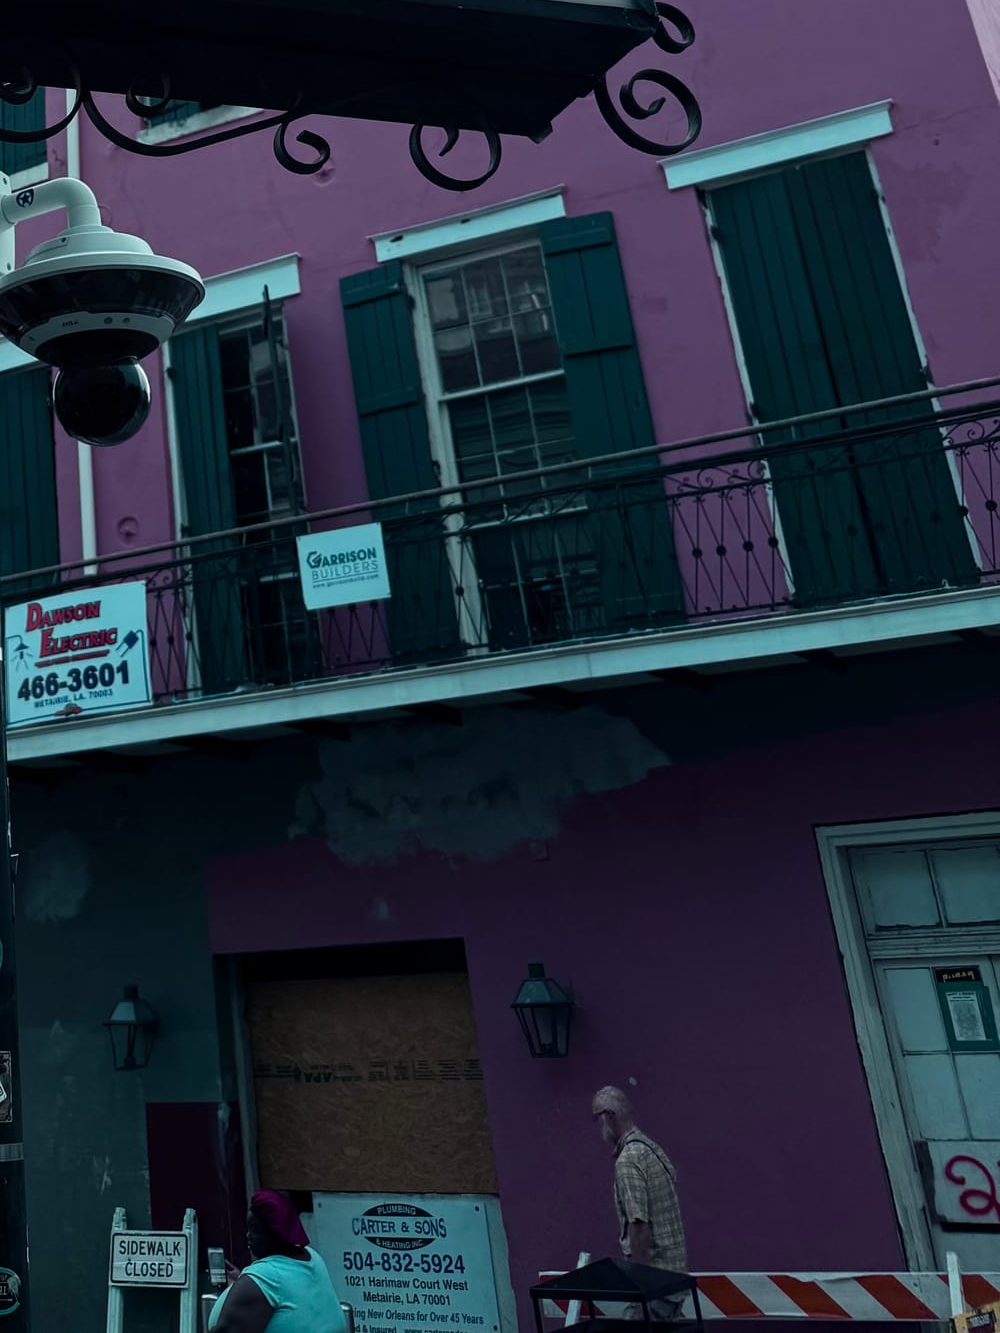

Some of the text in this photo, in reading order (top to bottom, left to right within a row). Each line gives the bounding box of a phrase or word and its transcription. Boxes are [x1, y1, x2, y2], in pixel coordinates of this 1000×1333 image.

[306, 547, 377, 569] GARRISON
[311, 560, 378, 580] BUILDERS
[17, 660, 131, 702] 466-3601
[377, 1205, 417, 1216] PLUMBING
[351, 1218, 447, 1238] CARTER & SONS
[119, 1240, 180, 1256] SIDEWALK
[382, 1239, 411, 1249] HEATING
[125, 1262, 173, 1277] CLOSED
[343, 1252, 465, 1274] 504-832-5924
[345, 1276, 468, 1290] 1021 Harimaw Court West
[363, 1291, 450, 1305] Metairie, LA 70001
[367, 1309, 384, 1319] New
[386, 1309, 415, 1321] Orleans
[416, 1311, 427, 1322] for
[430, 1312, 449, 1323] Over
[450, 1313, 460, 1323] 45
[461, 1314, 484, 1325] Years
